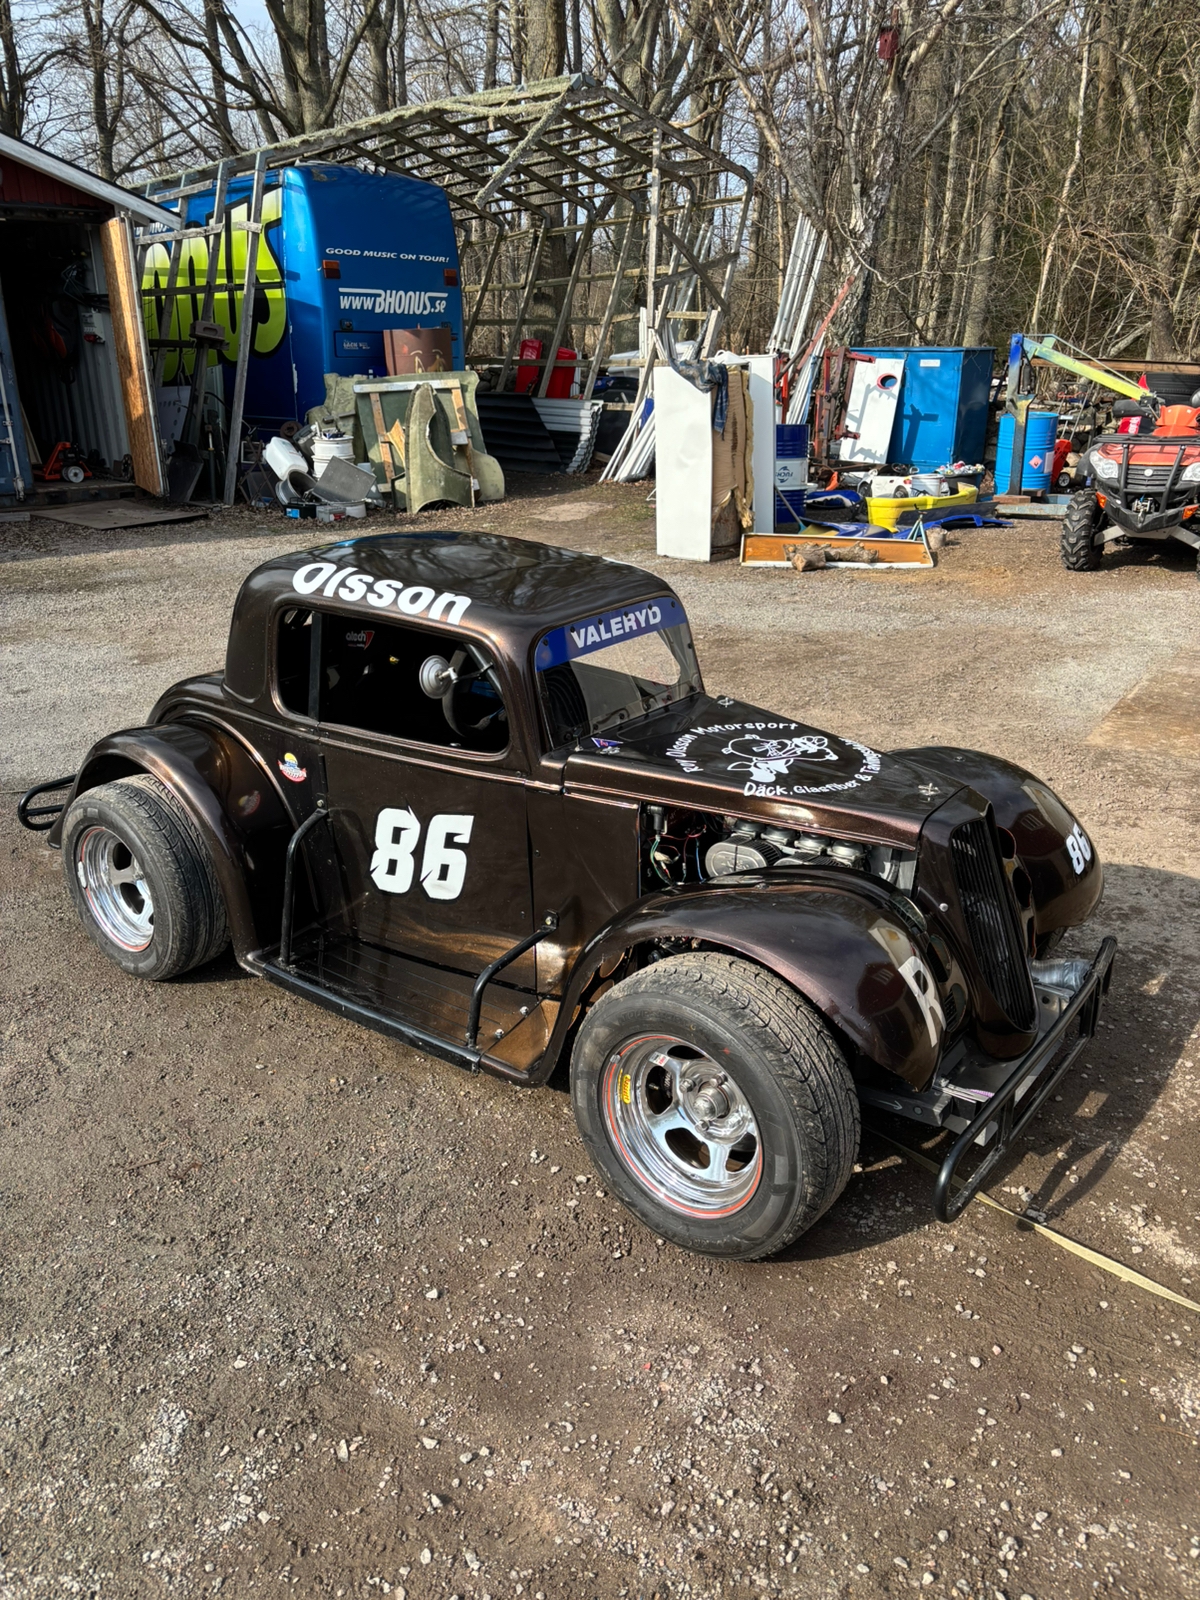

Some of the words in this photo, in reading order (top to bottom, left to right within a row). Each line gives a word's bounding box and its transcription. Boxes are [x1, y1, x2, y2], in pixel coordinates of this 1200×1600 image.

[325, 247, 361, 256] GOOD
[363, 250, 397, 259] MUSIC
[418, 254, 450, 263] TOUR!
[292, 562, 472, 626] Olsson
[570, 606, 662, 648] VALERYD
[665, 733, 698, 757] Olsson
[690, 722, 799, 735] Motorsport
[793, 779, 861, 794] Glasfiber
[854, 773, 873, 781] &
[369, 805, 474, 900] 86
[1066, 822, 1092, 875] 86
